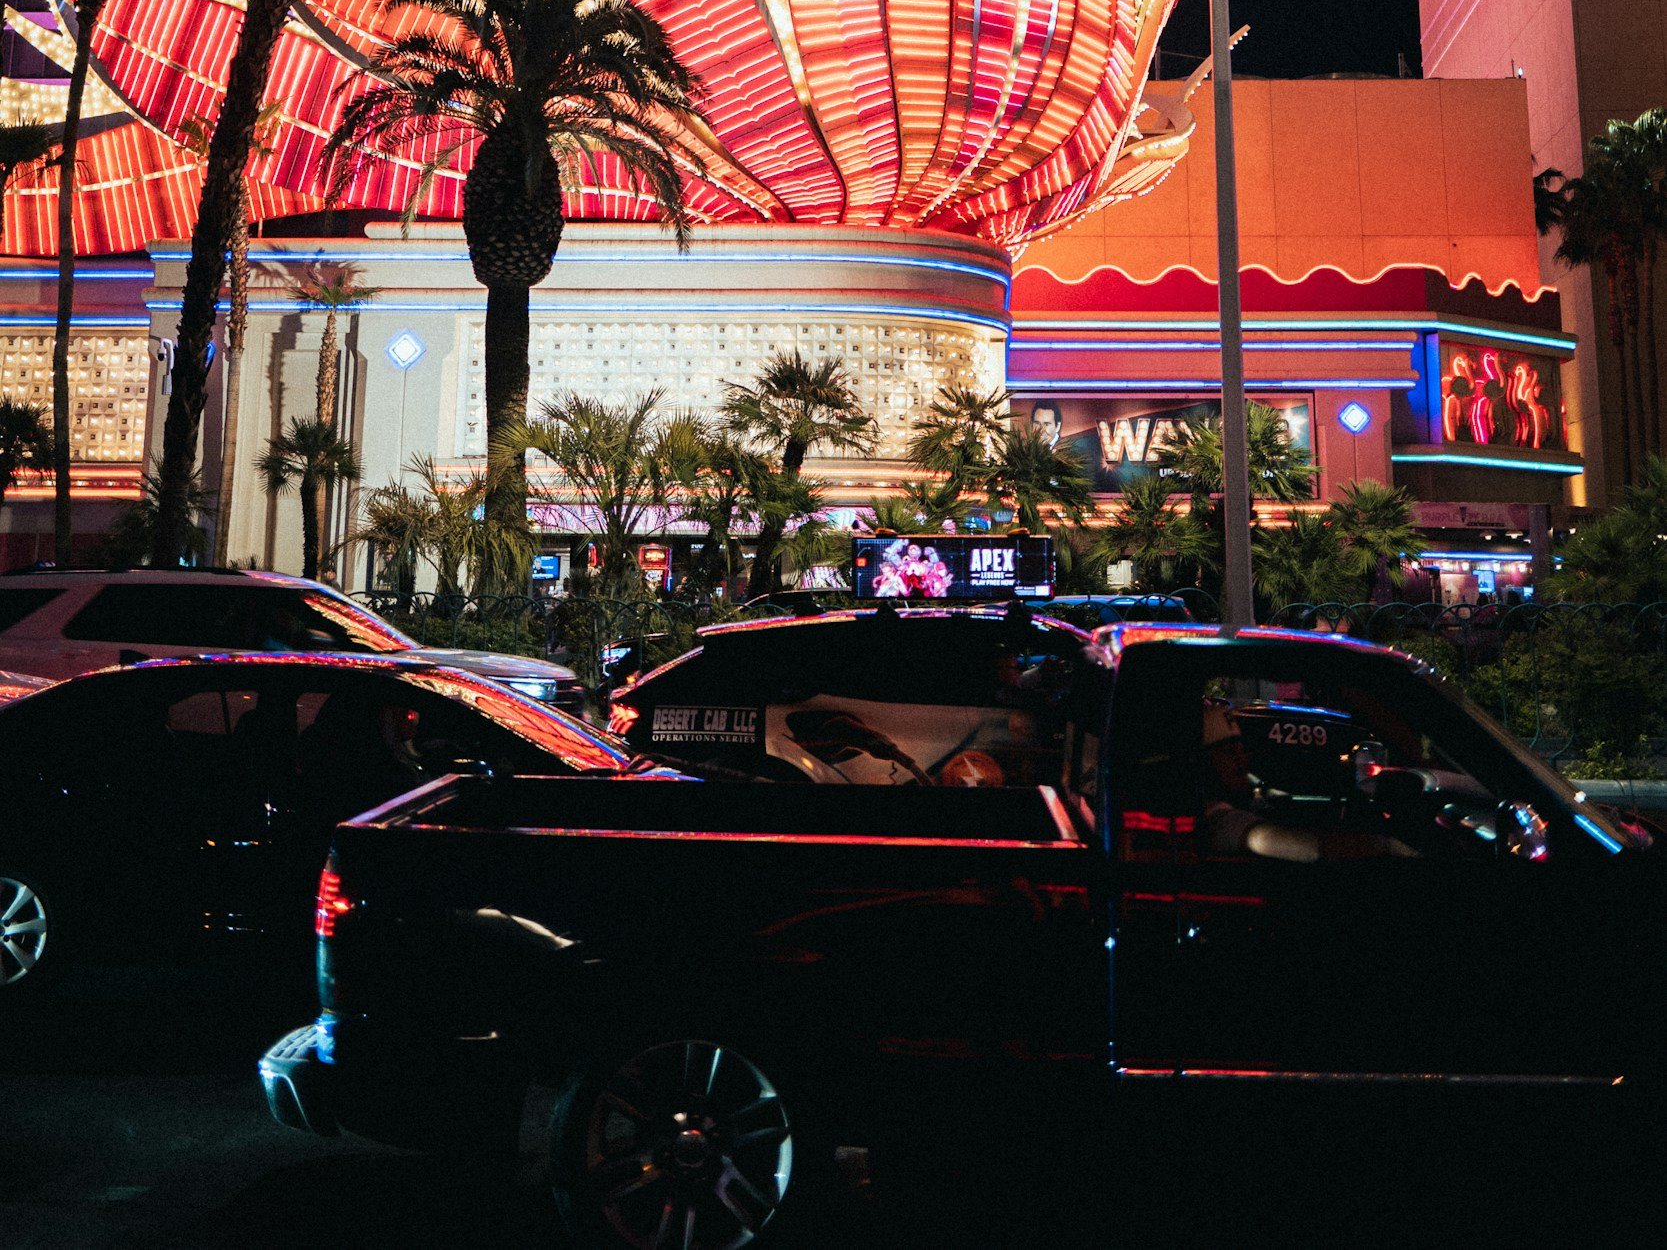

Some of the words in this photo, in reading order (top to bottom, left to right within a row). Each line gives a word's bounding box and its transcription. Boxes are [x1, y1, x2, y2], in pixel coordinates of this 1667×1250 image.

[970, 549, 1014, 571] APEX
[652, 709, 698, 730] DESERT
[704, 710, 727, 731] CAB
[733, 711, 757, 732] LLC
[652, 734, 716, 742] OPERATIONS
[719, 735, 756, 743] SERIES
[1268, 723, 1327, 746] 4289
